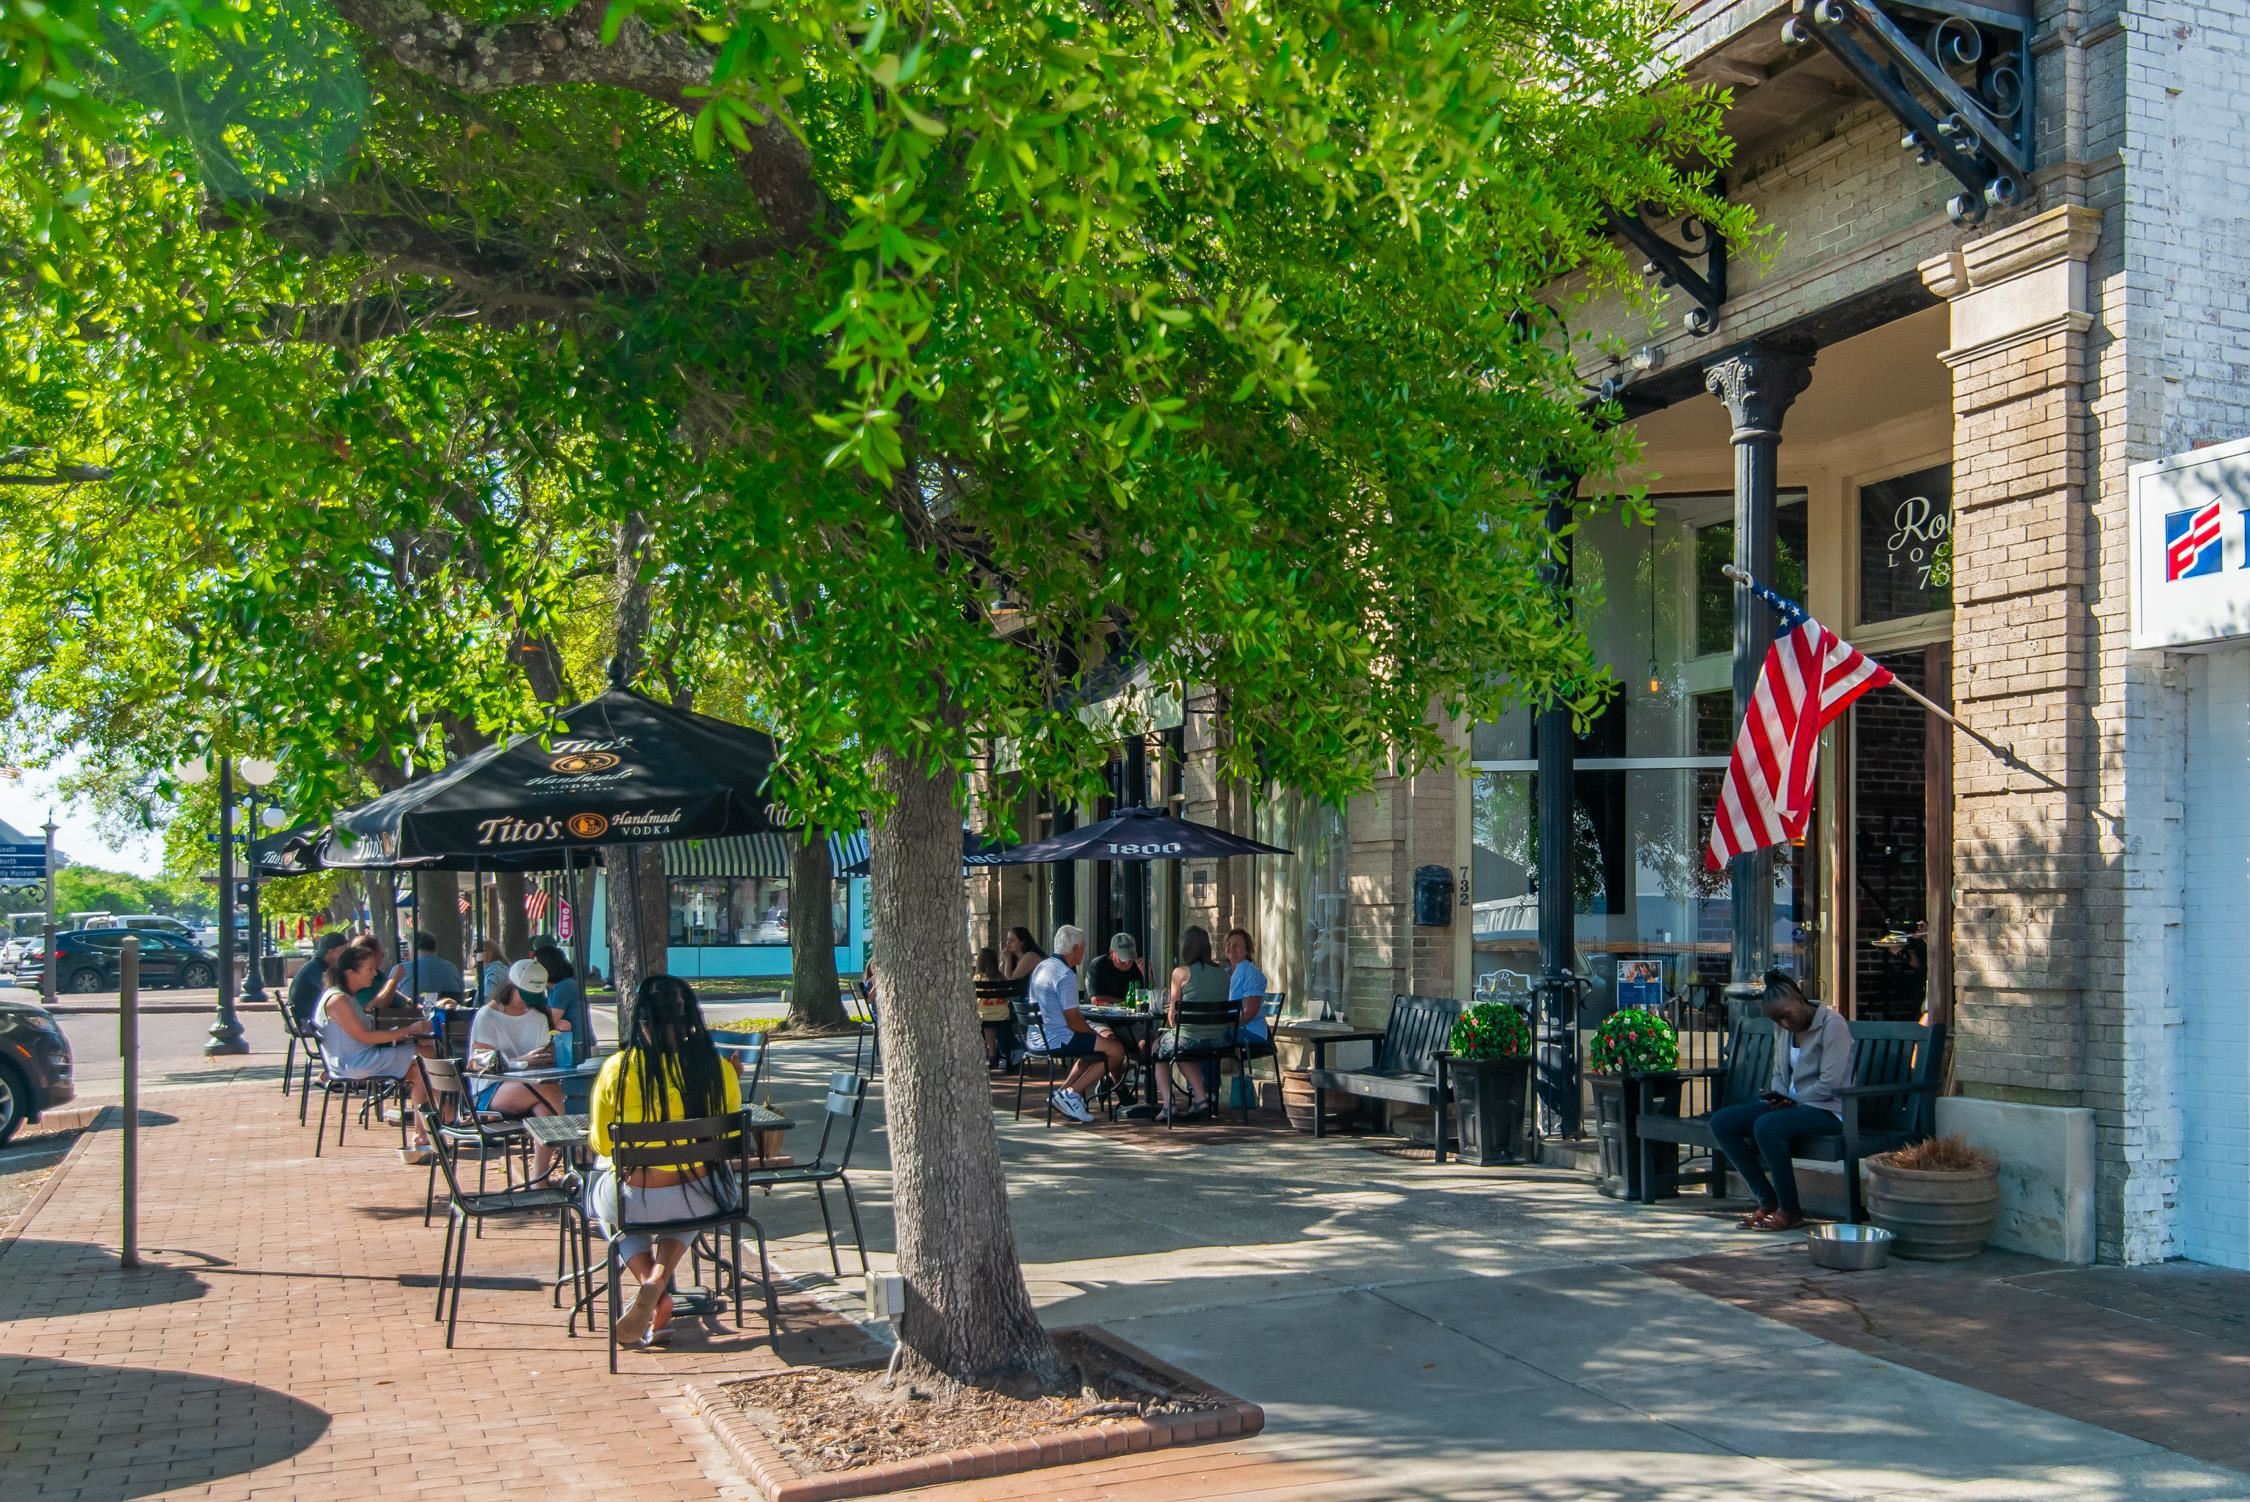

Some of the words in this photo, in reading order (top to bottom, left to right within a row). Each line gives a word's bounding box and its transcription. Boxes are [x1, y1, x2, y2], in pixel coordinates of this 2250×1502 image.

[552, 737, 633, 754] Tito's
[525, 768, 634, 786] Handmade
[549, 782, 602, 790] VODKA
[478, 815, 563, 844] Tito's
[611, 807, 681, 826] Handmade
[622, 825, 671, 836] VODKA
[1107, 842, 1181, 855] 1800
[963, 853, 1012, 864] 180
[1460, 865, 1469, 906] 732
[562, 908, 570, 935] OPEN
